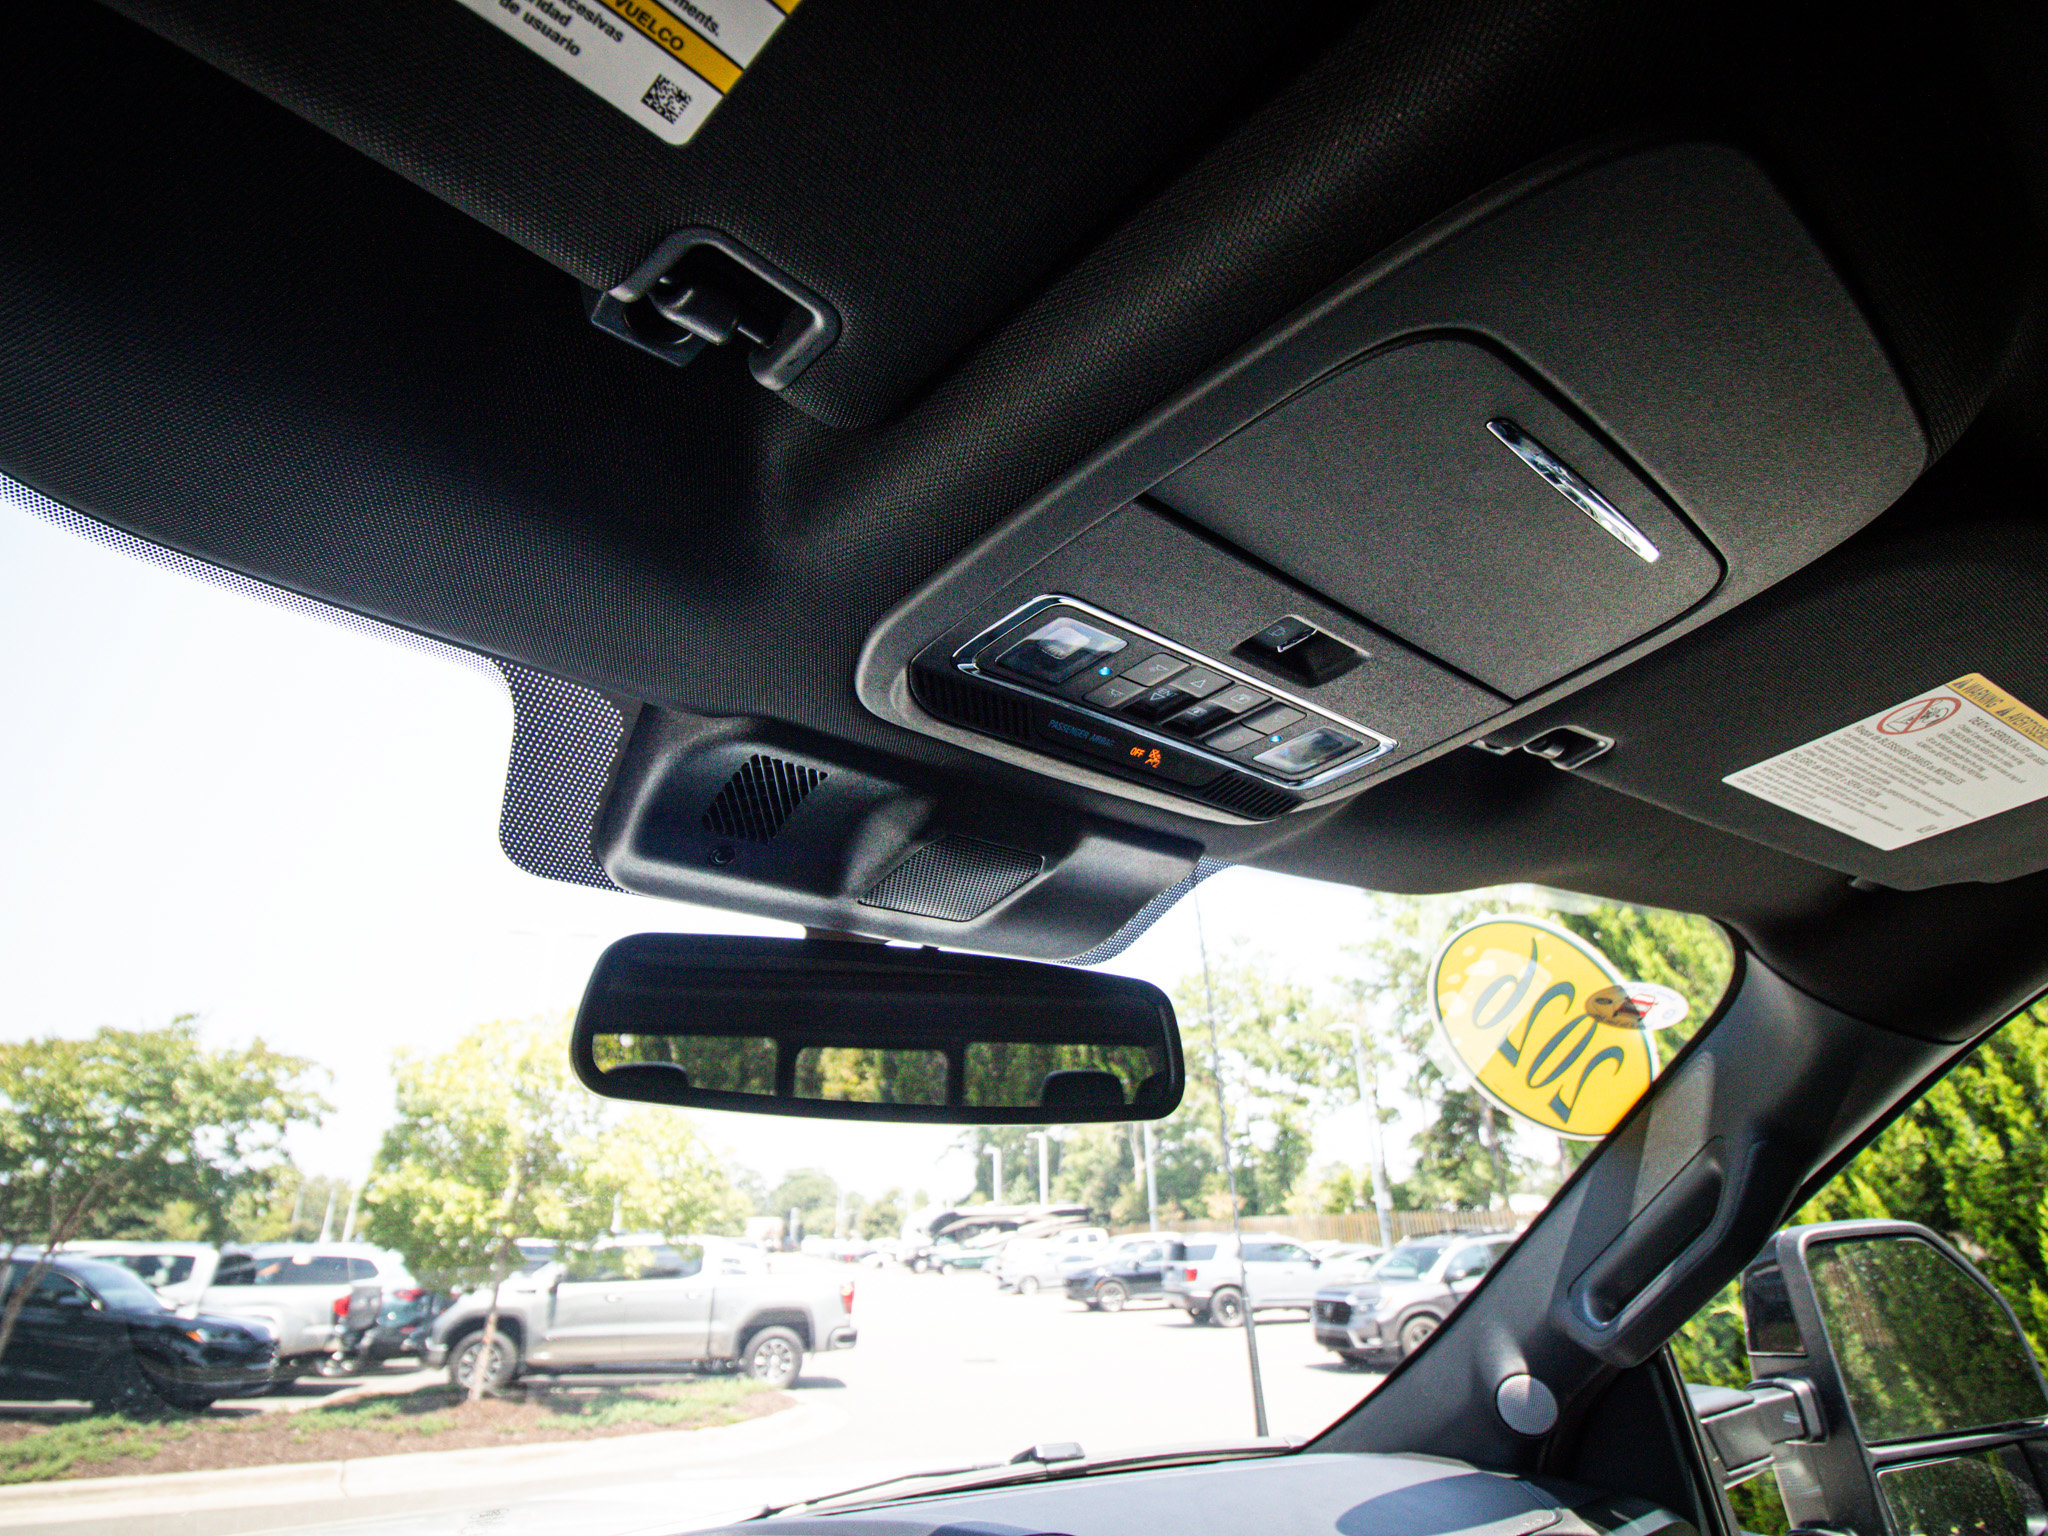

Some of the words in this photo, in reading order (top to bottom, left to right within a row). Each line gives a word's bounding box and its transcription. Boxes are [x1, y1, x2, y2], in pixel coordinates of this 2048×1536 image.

[523, 11, 580, 55] usuario
[562, 0, 624, 43] cesivas
[671, 0, 719, 37] ments.
[1960, 682, 2005, 708] WARNING
[1047, 720, 1090, 739] PASSENGER
[1091, 733, 1116, 747] AIRBAG
[1130, 746, 1146, 758] OFF
